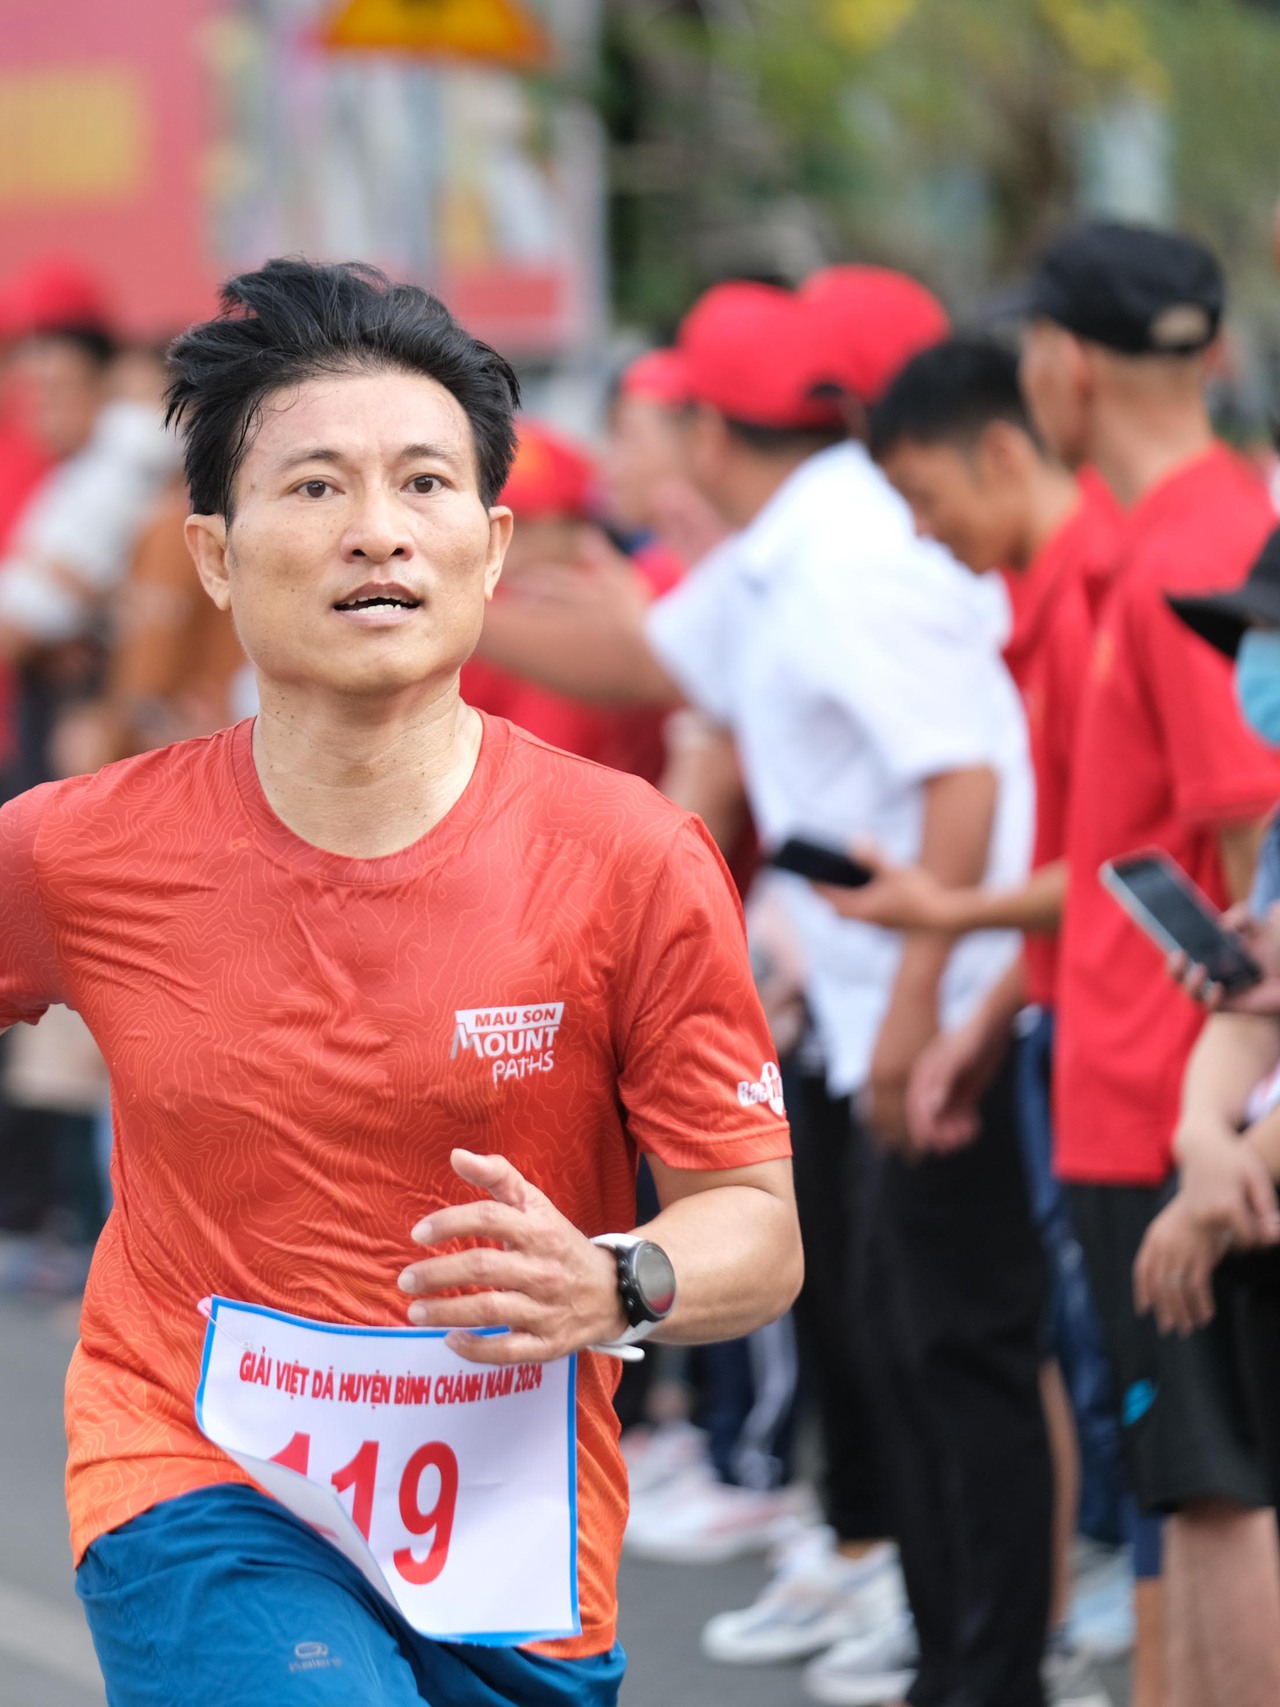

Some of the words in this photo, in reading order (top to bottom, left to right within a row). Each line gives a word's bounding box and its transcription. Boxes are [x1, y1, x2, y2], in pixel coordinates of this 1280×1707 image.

[474, 1011, 518, 1028] MAU
[521, 1007, 557, 1024] SON
[449, 1022, 560, 1060] MOUNT
[491, 1049, 555, 1090] PATHS
[238, 1345, 273, 1387] GIẢI
[275, 1359, 311, 1400] VIỆT
[337, 1369, 393, 1410] HUYỆN
[433, 1369, 485, 1405] CHÁNH
[513, 1361, 544, 1394] 2024
